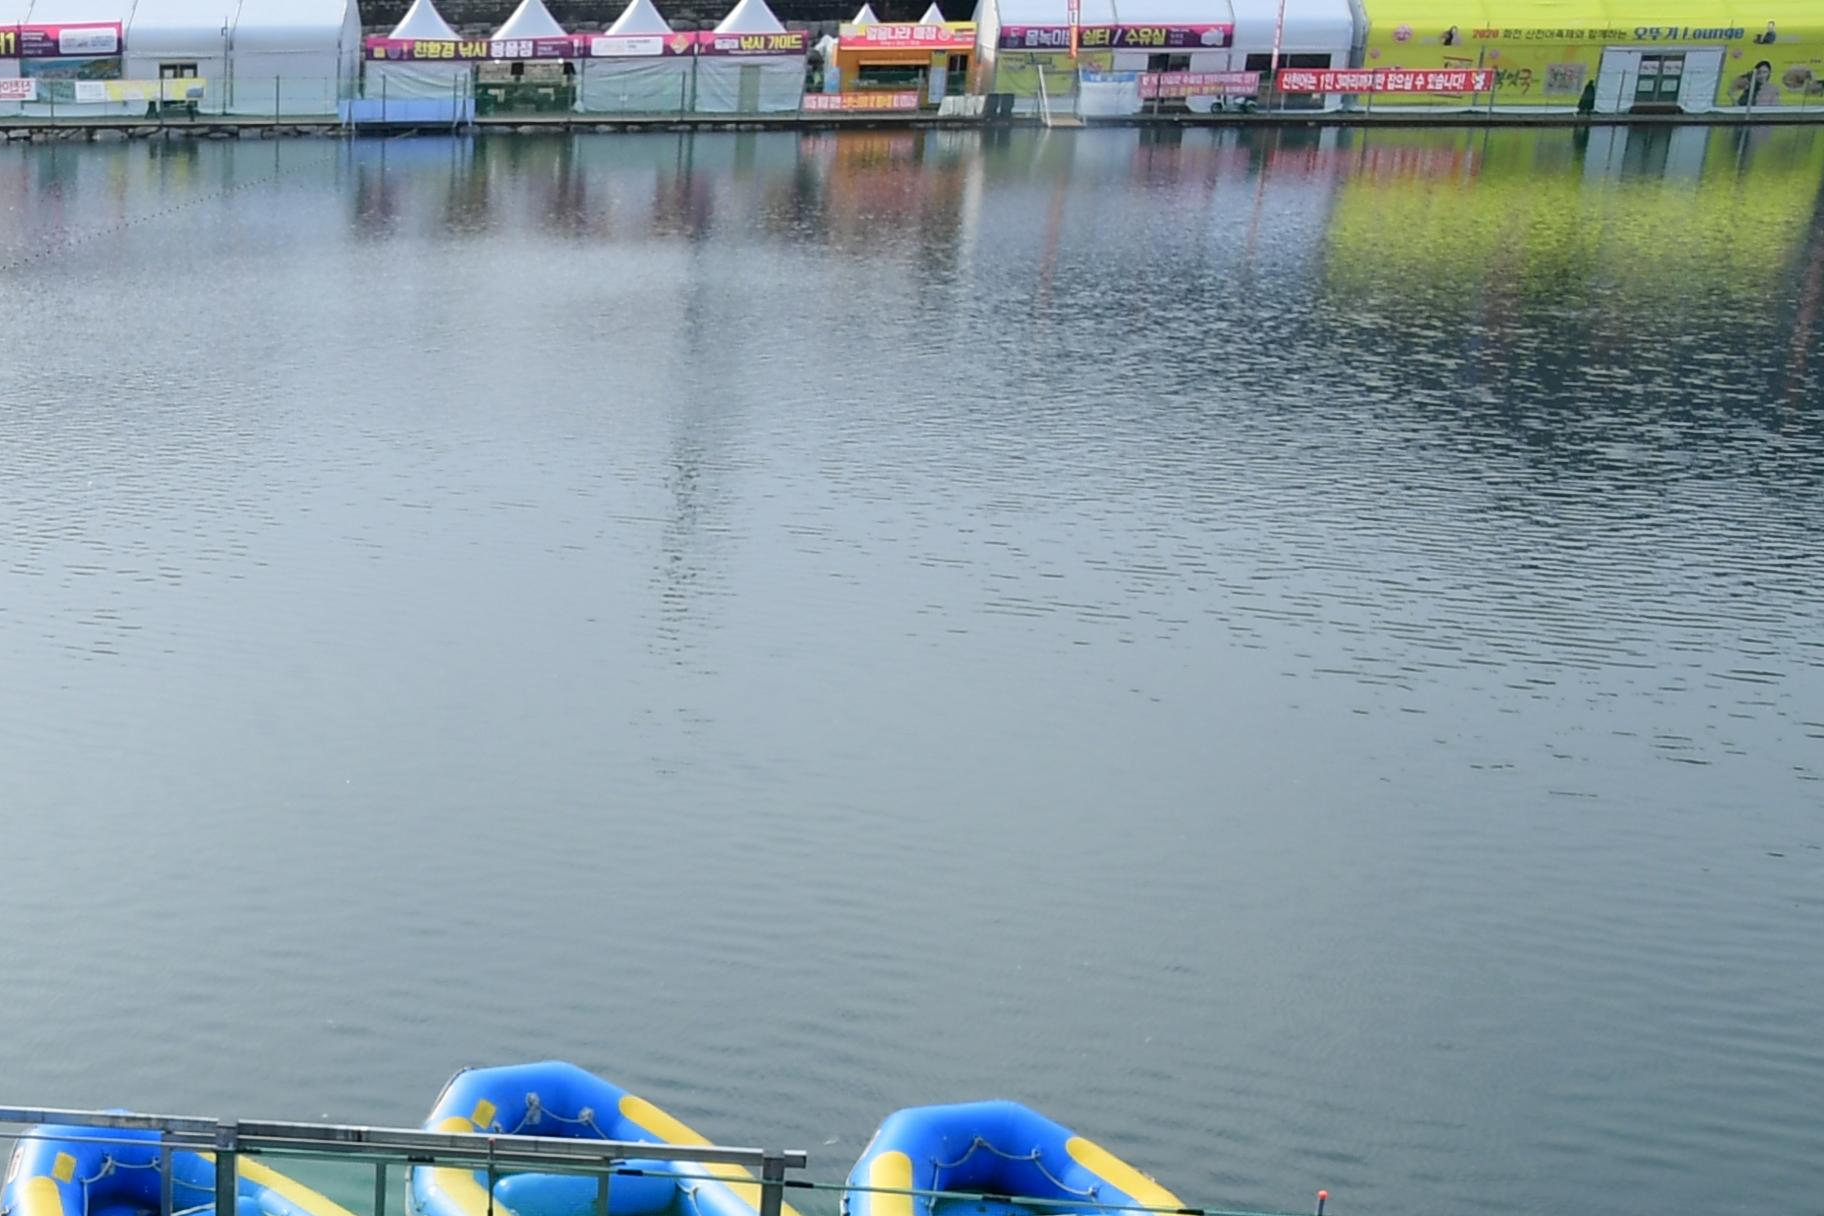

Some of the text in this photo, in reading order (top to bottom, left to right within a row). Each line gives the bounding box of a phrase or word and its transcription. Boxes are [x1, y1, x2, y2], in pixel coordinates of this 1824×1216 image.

[1082, 28, 1110, 45] 쉼터
[1125, 28, 1166, 45] 수유실
[414, 41, 455, 58] 친환경
[459, 41, 487, 57] 낚시
[491, 41, 533, 57] 용품점
[1282, 72, 1317, 89] 산천어는
[1414, 73, 1424, 89] 수
